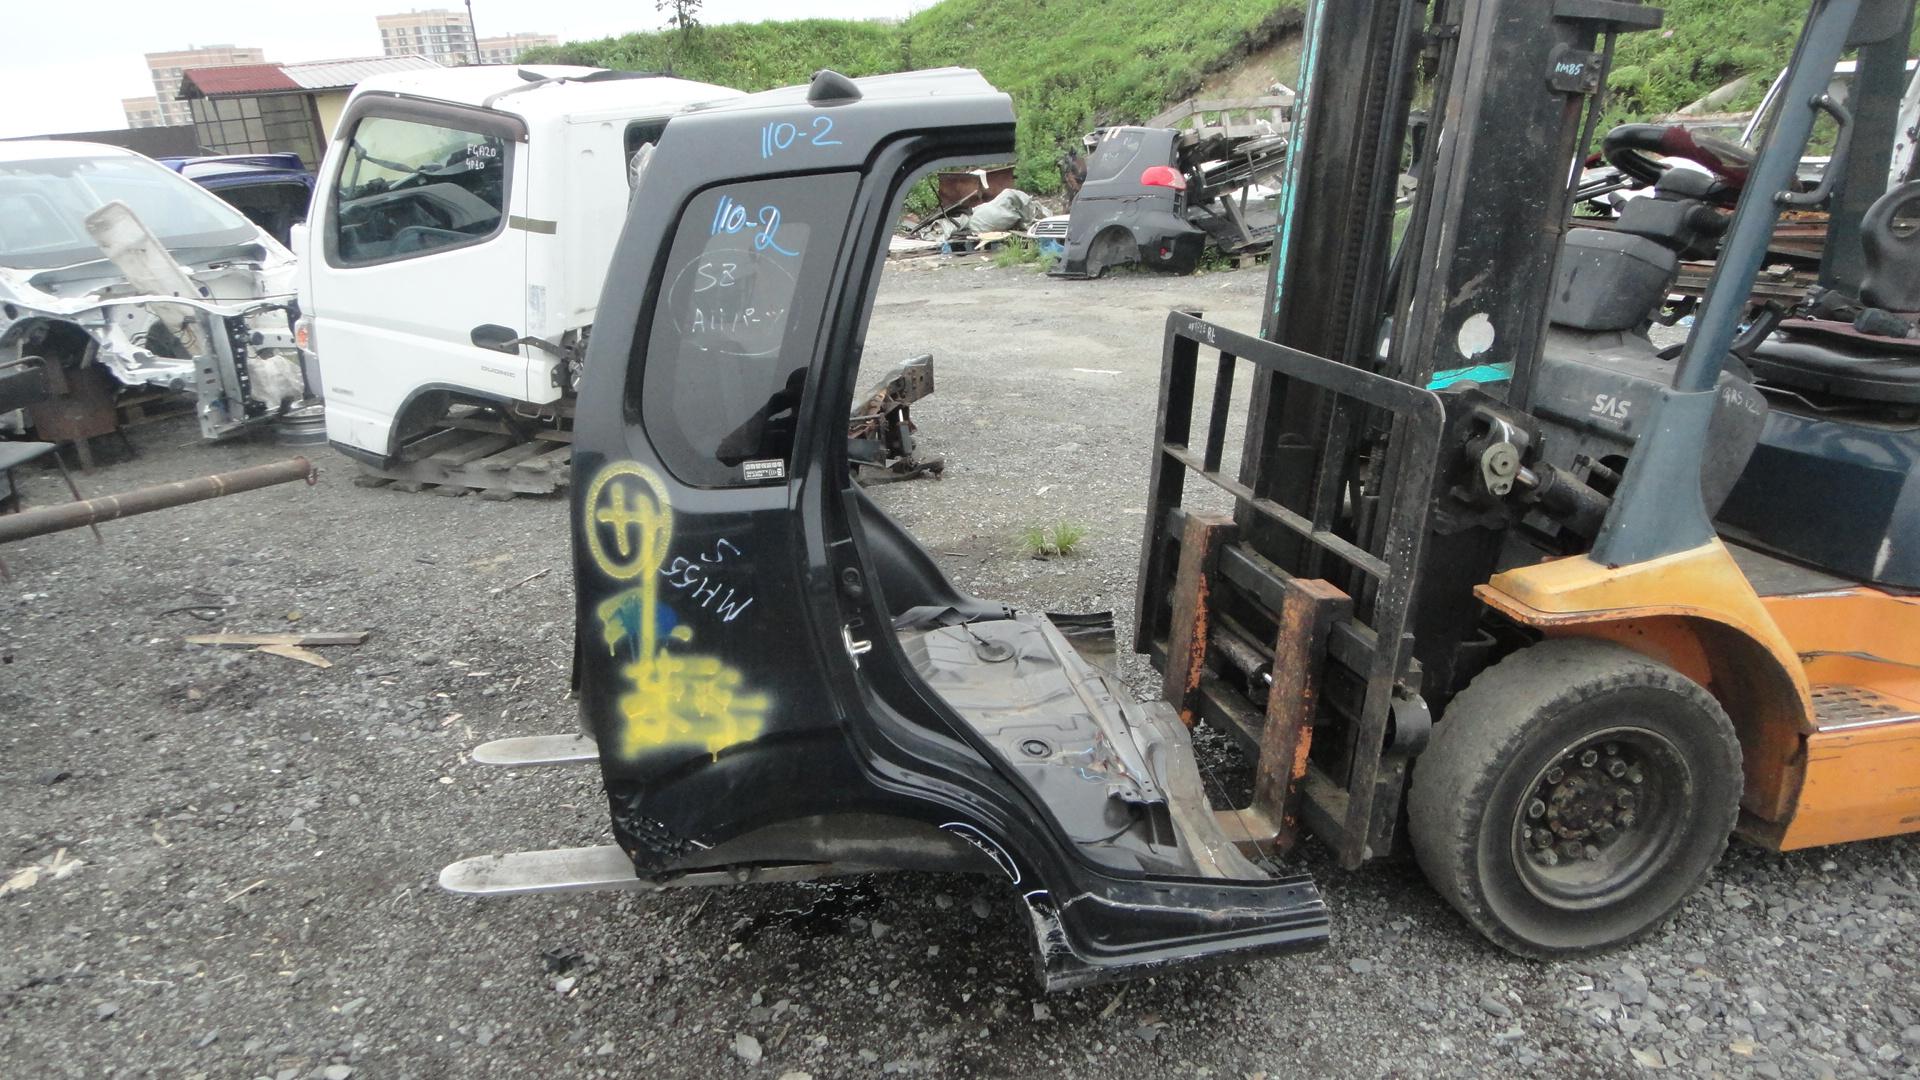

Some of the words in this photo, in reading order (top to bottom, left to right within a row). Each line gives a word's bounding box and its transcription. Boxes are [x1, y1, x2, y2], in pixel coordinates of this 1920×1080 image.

[762, 116, 842, 158] 110-2
[712, 195, 799, 256] 110-2
[1591, 393, 1632, 419] SAS
